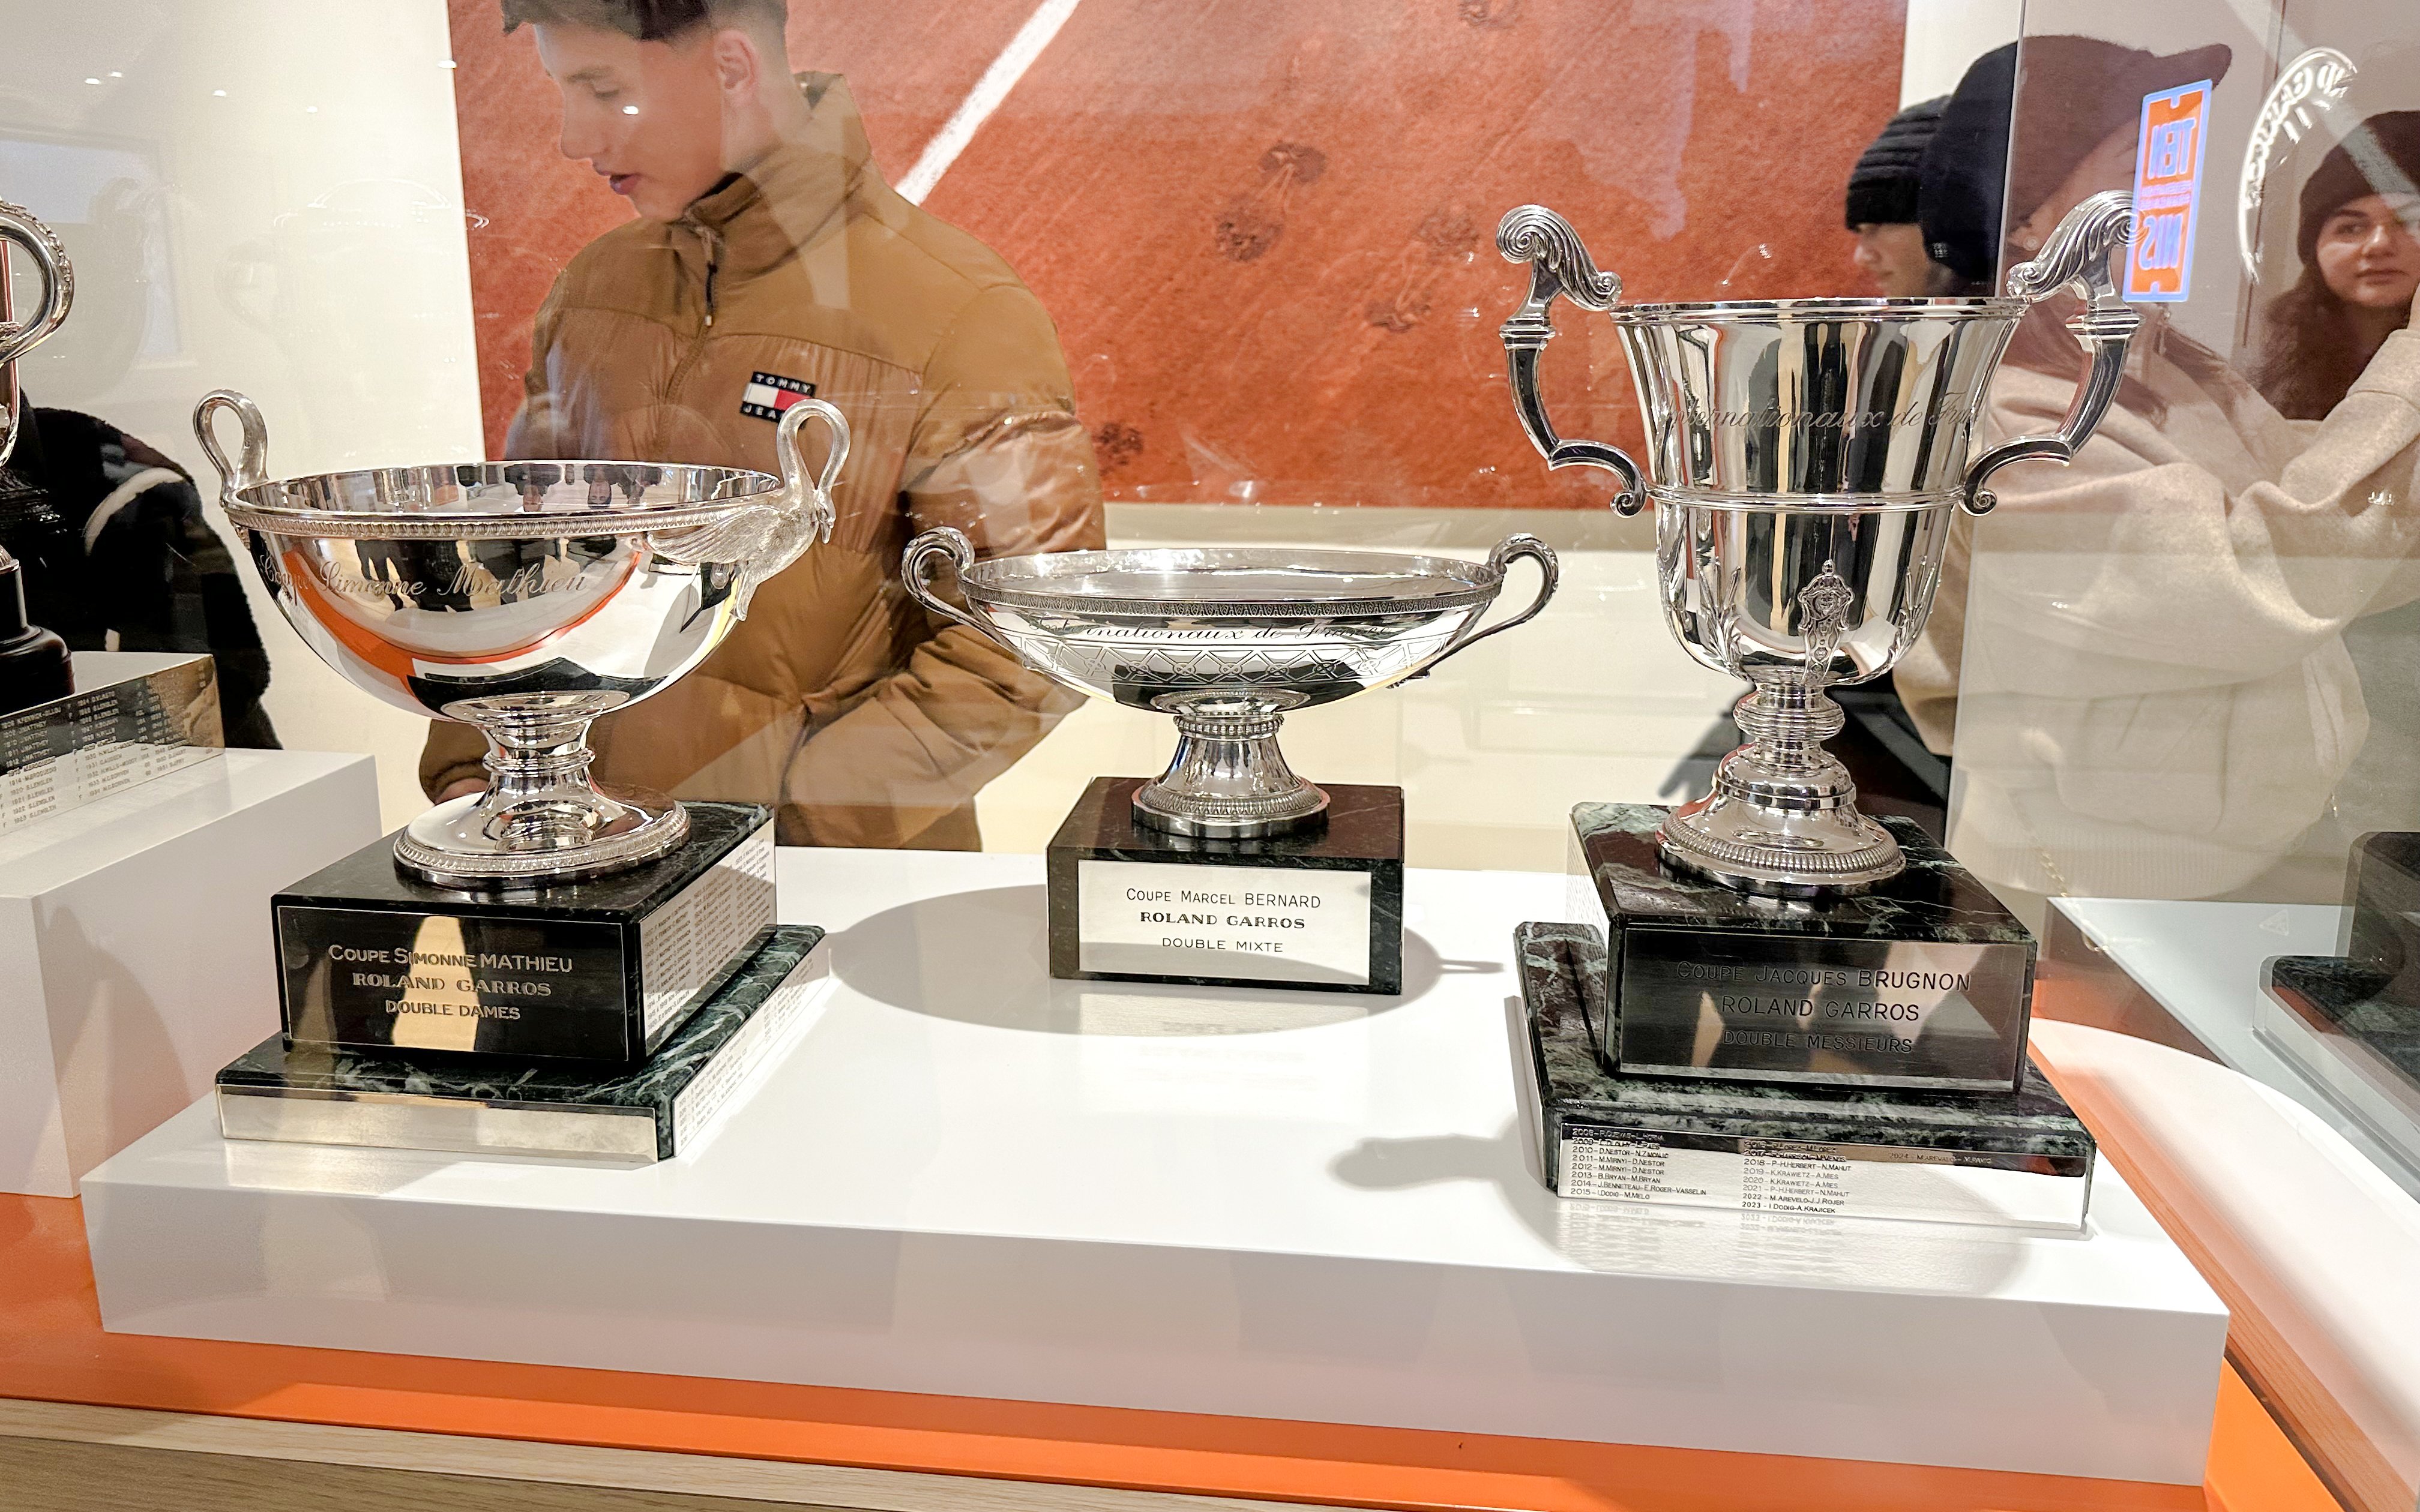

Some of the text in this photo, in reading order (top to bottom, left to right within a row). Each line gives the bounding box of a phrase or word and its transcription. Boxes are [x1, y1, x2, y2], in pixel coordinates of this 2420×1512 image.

[756, 373, 811, 393] TOMMY
[743, 404, 785, 419] JEA
[1888, 401, 1922, 426] de
[437, 562, 588, 596] Mathieu
[1253, 624, 1283, 640] de
[1127, 888, 1320, 908] COUPE MARCEL BERNARD
[1140, 912, 1305, 929] ROLAND GARROS
[1163, 937, 1283, 952] DOUBLE MIXTE
[328, 944, 573, 973] COUPE SIMONNE MATHIEU
[352, 972, 552, 997] ROLAND GARROS
[1676, 961, 1972, 991] COUPE JACQUES BRUGNON
[385, 999, 521, 1020] DOUBLE DAMES
[1722, 995, 1919, 1021] ROLAND GARROS
[1723, 1030, 1913, 1053] DOUBLE MESSIEURS
